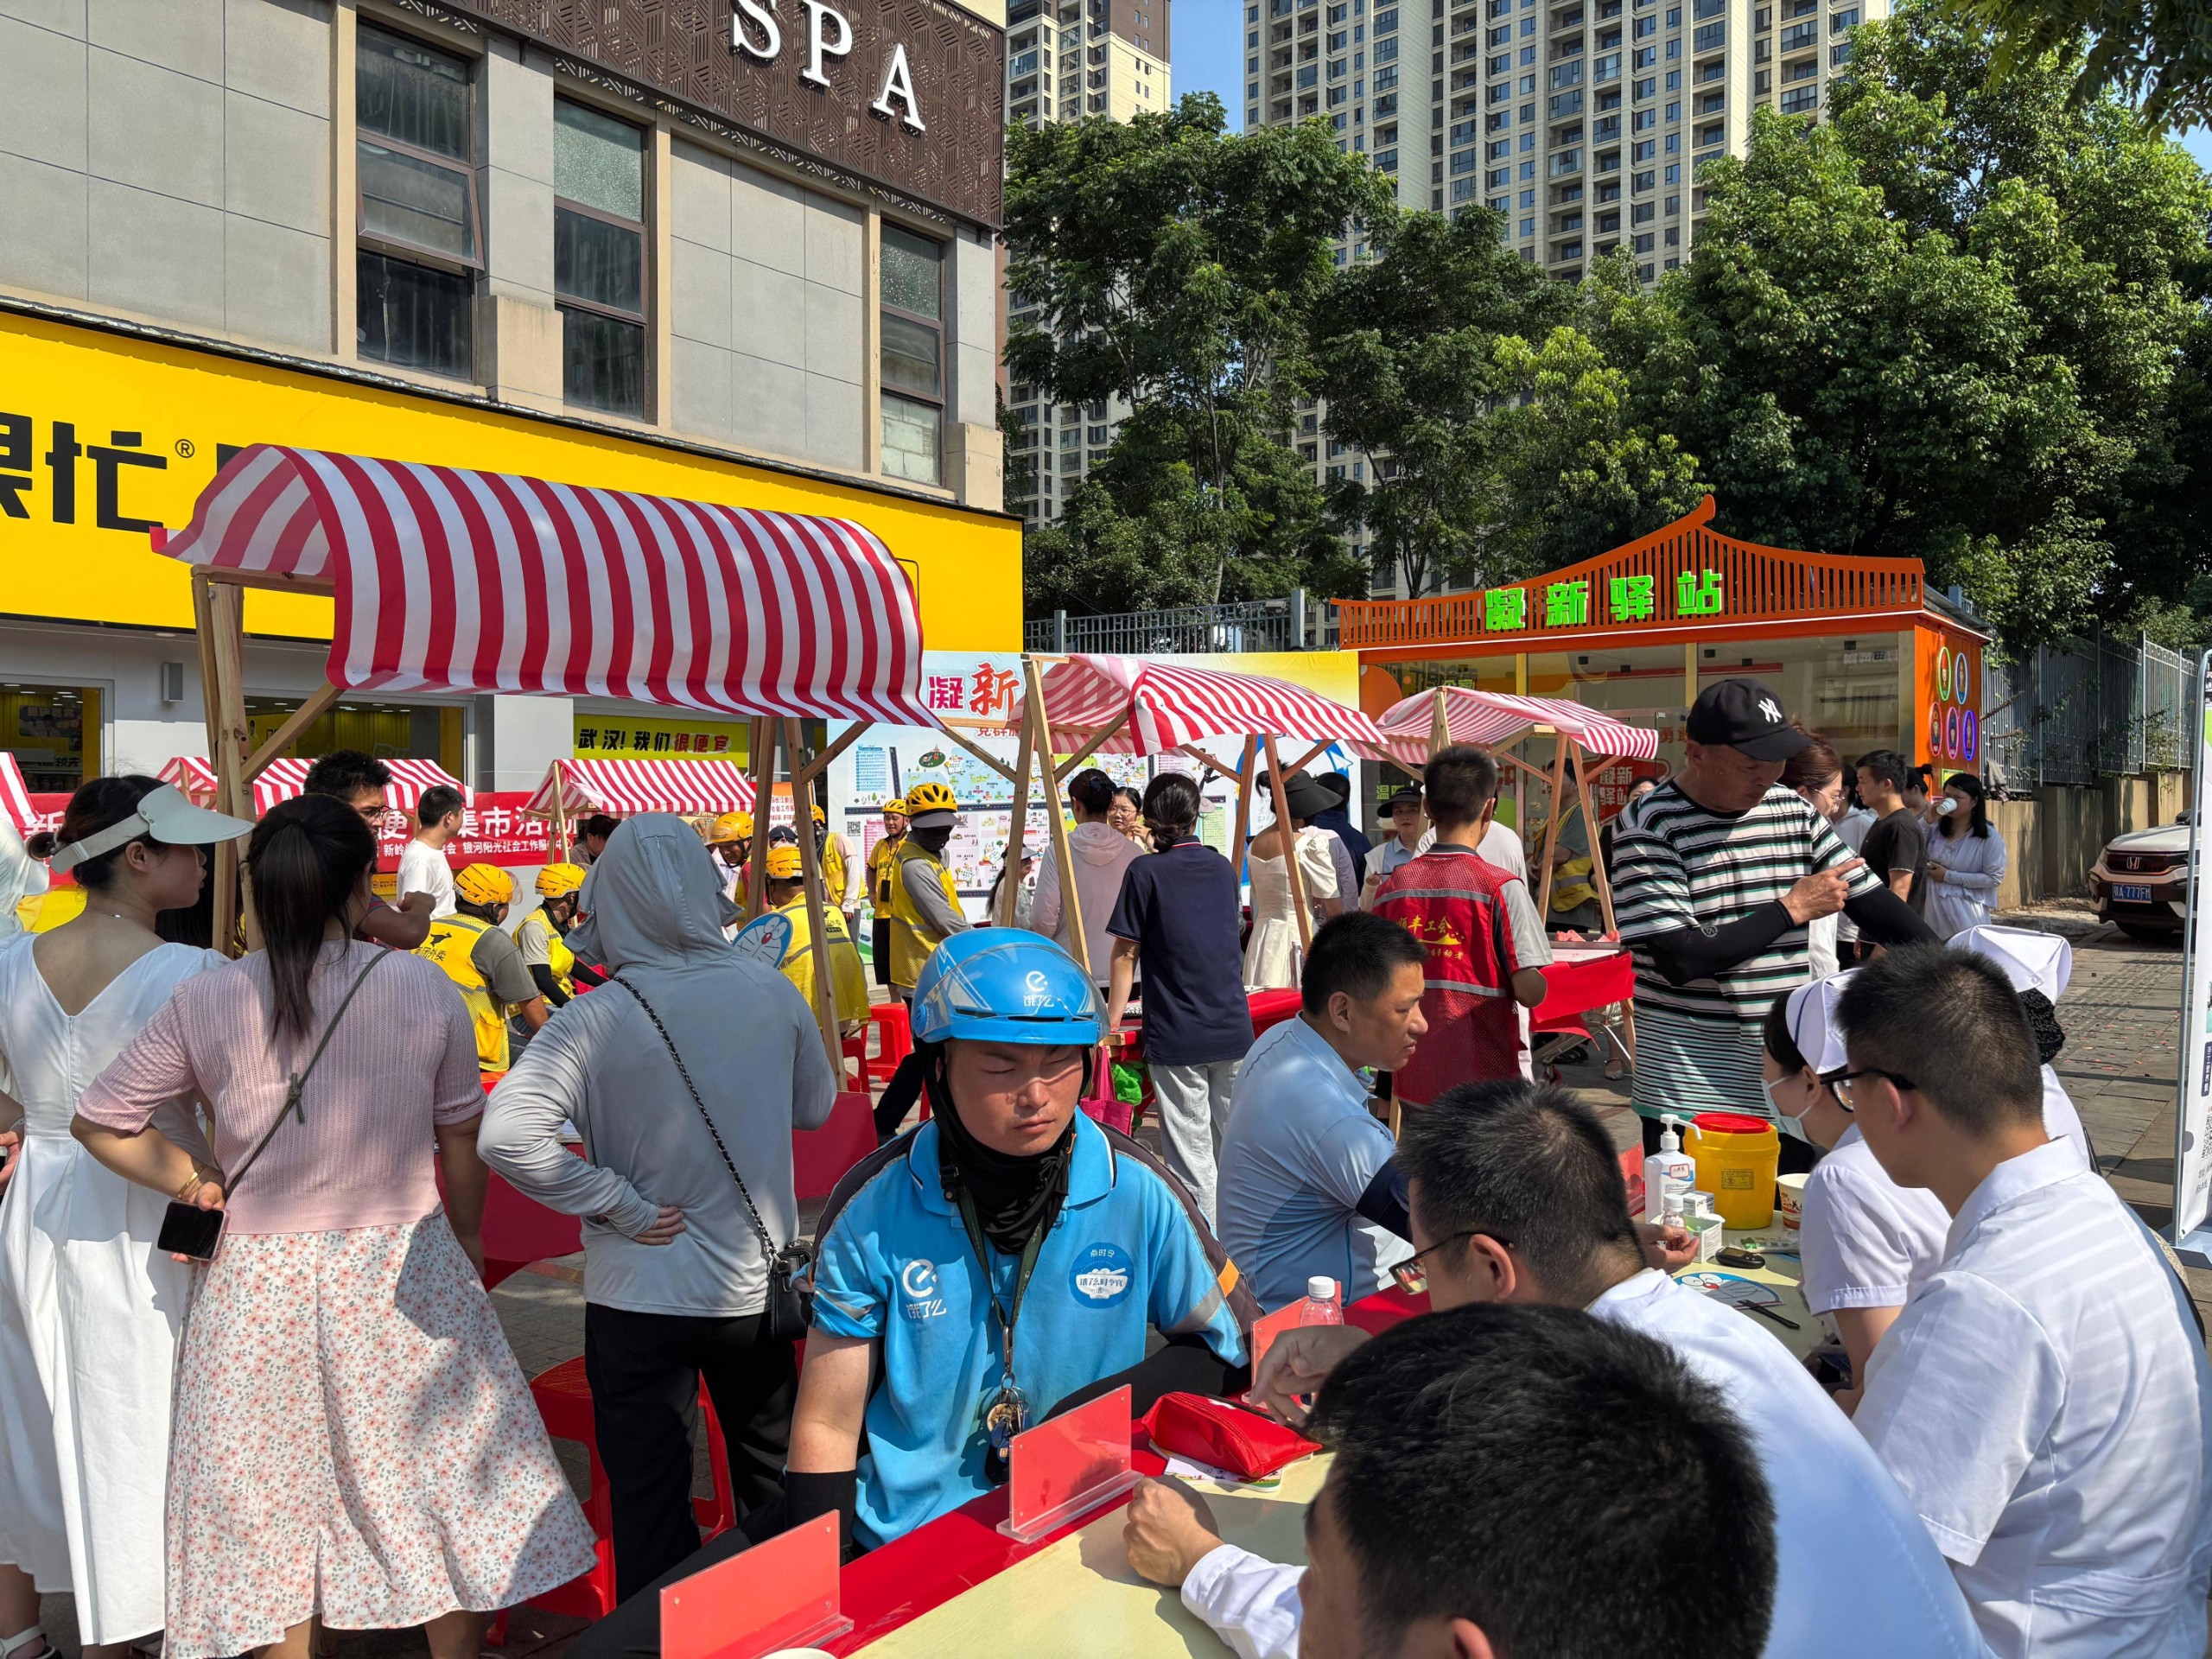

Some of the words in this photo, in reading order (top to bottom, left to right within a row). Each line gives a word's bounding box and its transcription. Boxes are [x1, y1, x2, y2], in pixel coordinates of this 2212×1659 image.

[733, 0, 925, 131] SPA
[1484, 569, 1722, 631] 凝新驿站
